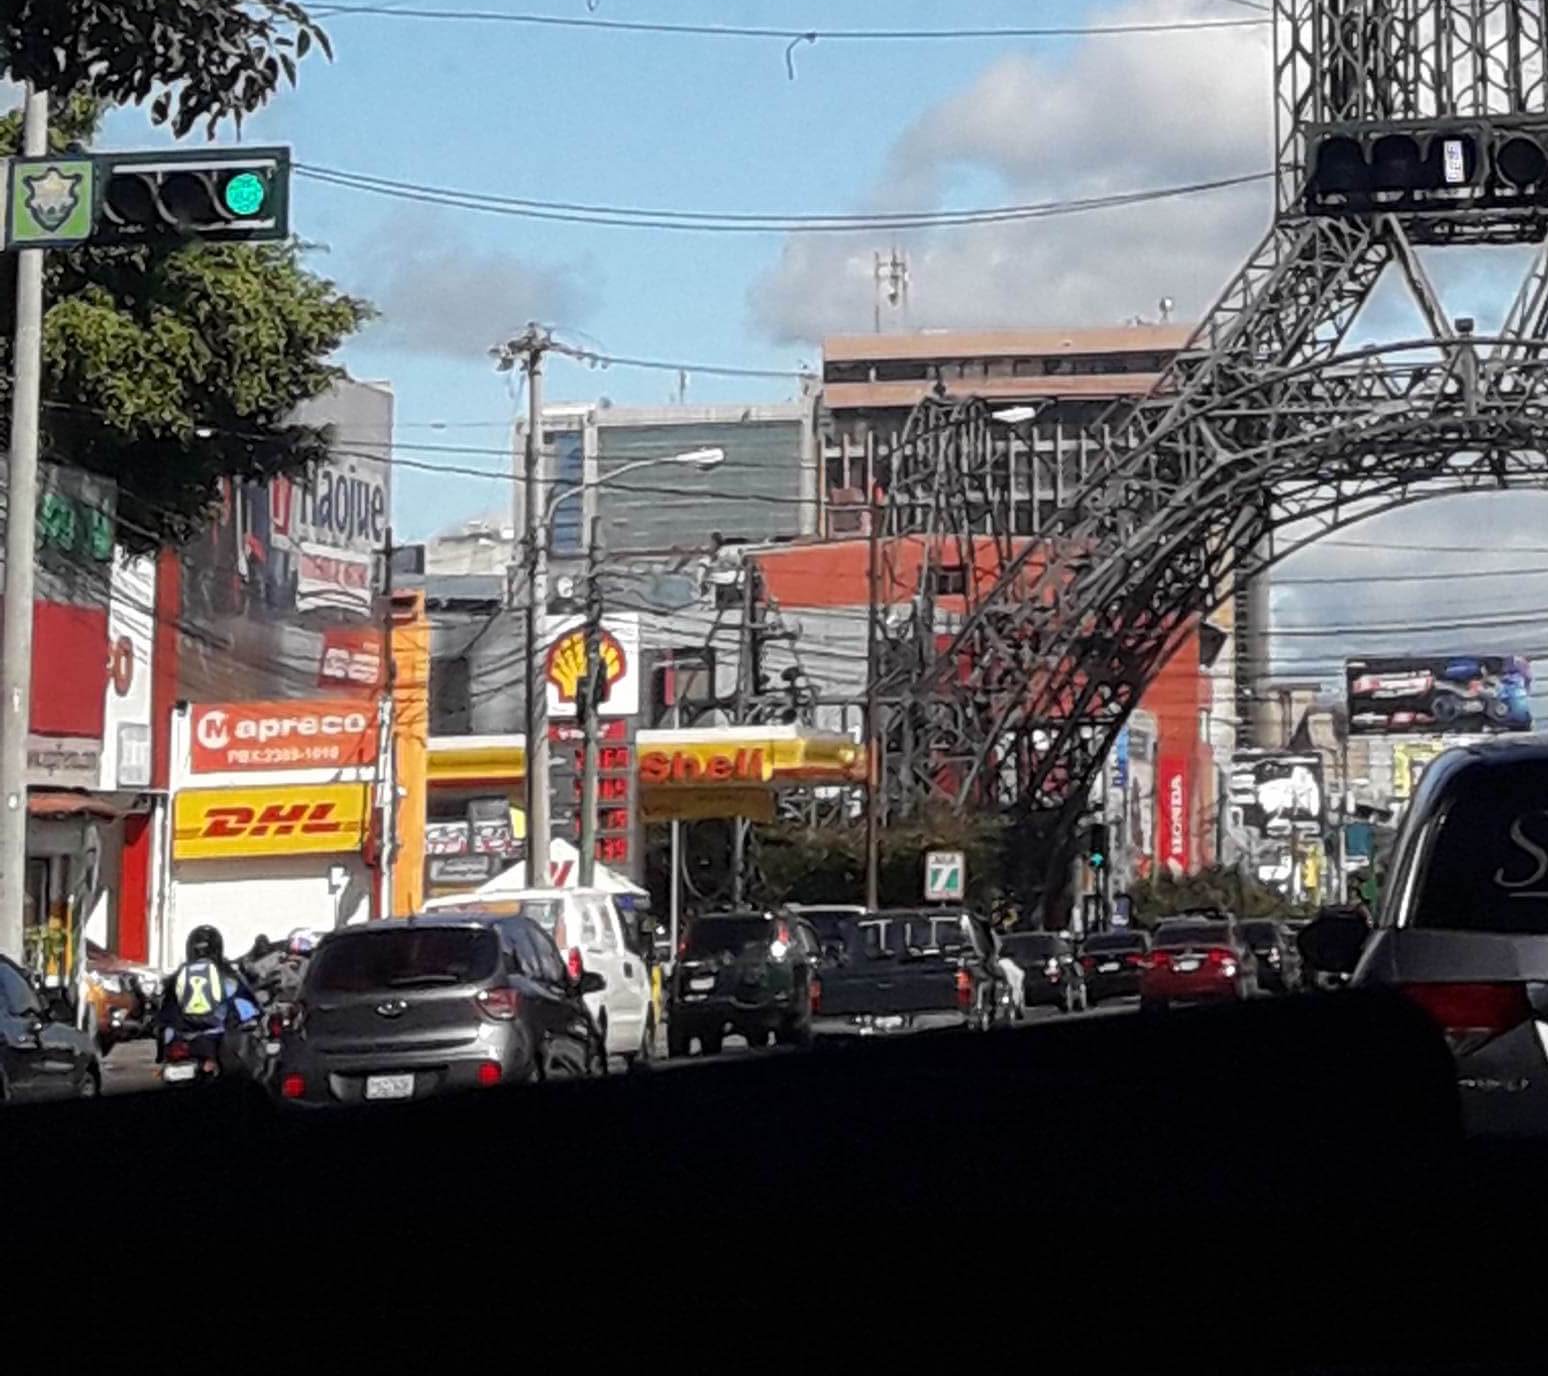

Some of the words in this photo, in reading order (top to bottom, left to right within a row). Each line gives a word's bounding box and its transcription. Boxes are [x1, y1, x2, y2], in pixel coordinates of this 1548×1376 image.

[640, 748, 765, 784] Shell
[201, 802, 337, 838] DHL
[1170, 774, 1183, 855] HONDA
